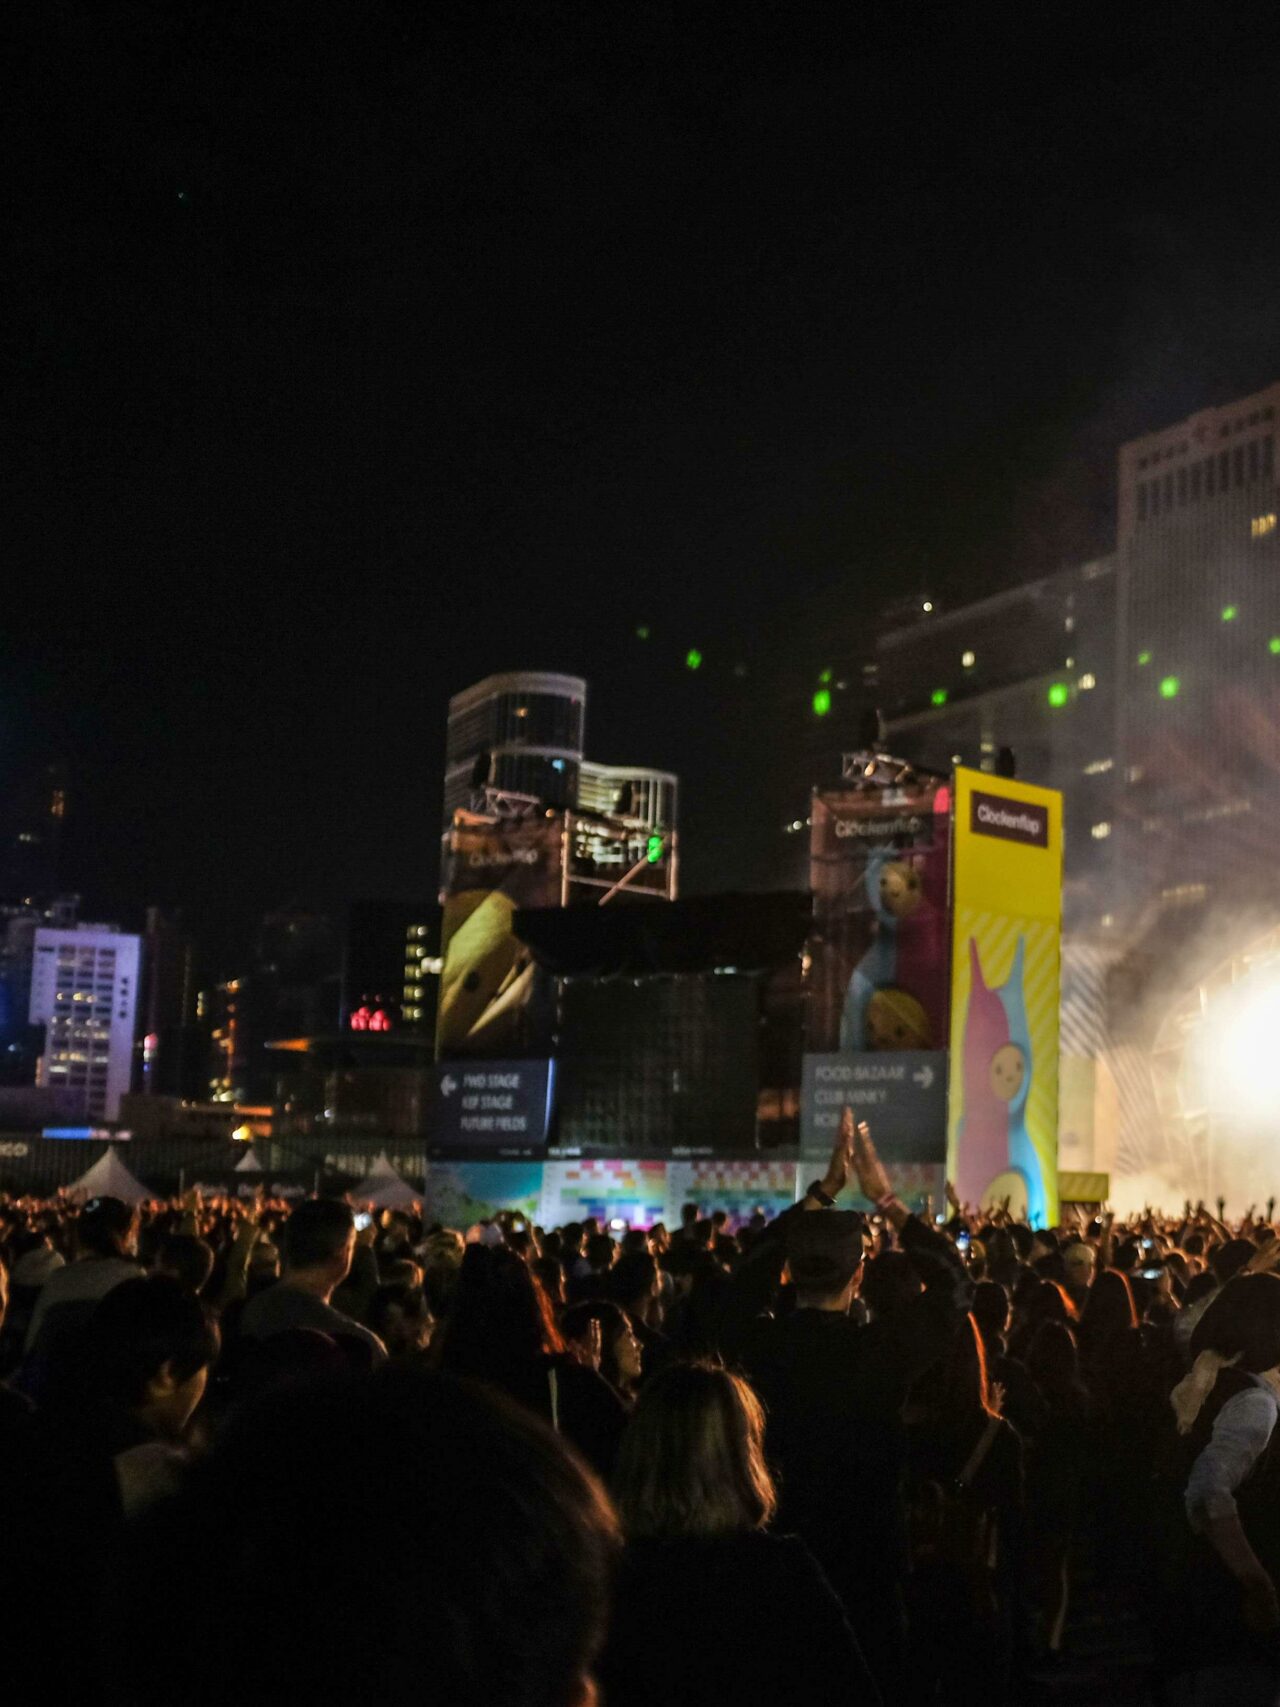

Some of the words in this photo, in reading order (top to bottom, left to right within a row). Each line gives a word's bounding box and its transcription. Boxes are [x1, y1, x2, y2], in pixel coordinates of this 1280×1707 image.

[487, 1073, 520, 1089] STAGE
[815, 1066, 851, 1082] FOOD
[854, 1065, 905, 1081] BAZAAR
[481, 1095, 513, 1110] STAGE
[460, 1116, 494, 1132] FUTURE
[496, 1116, 527, 1132] FIELDS
